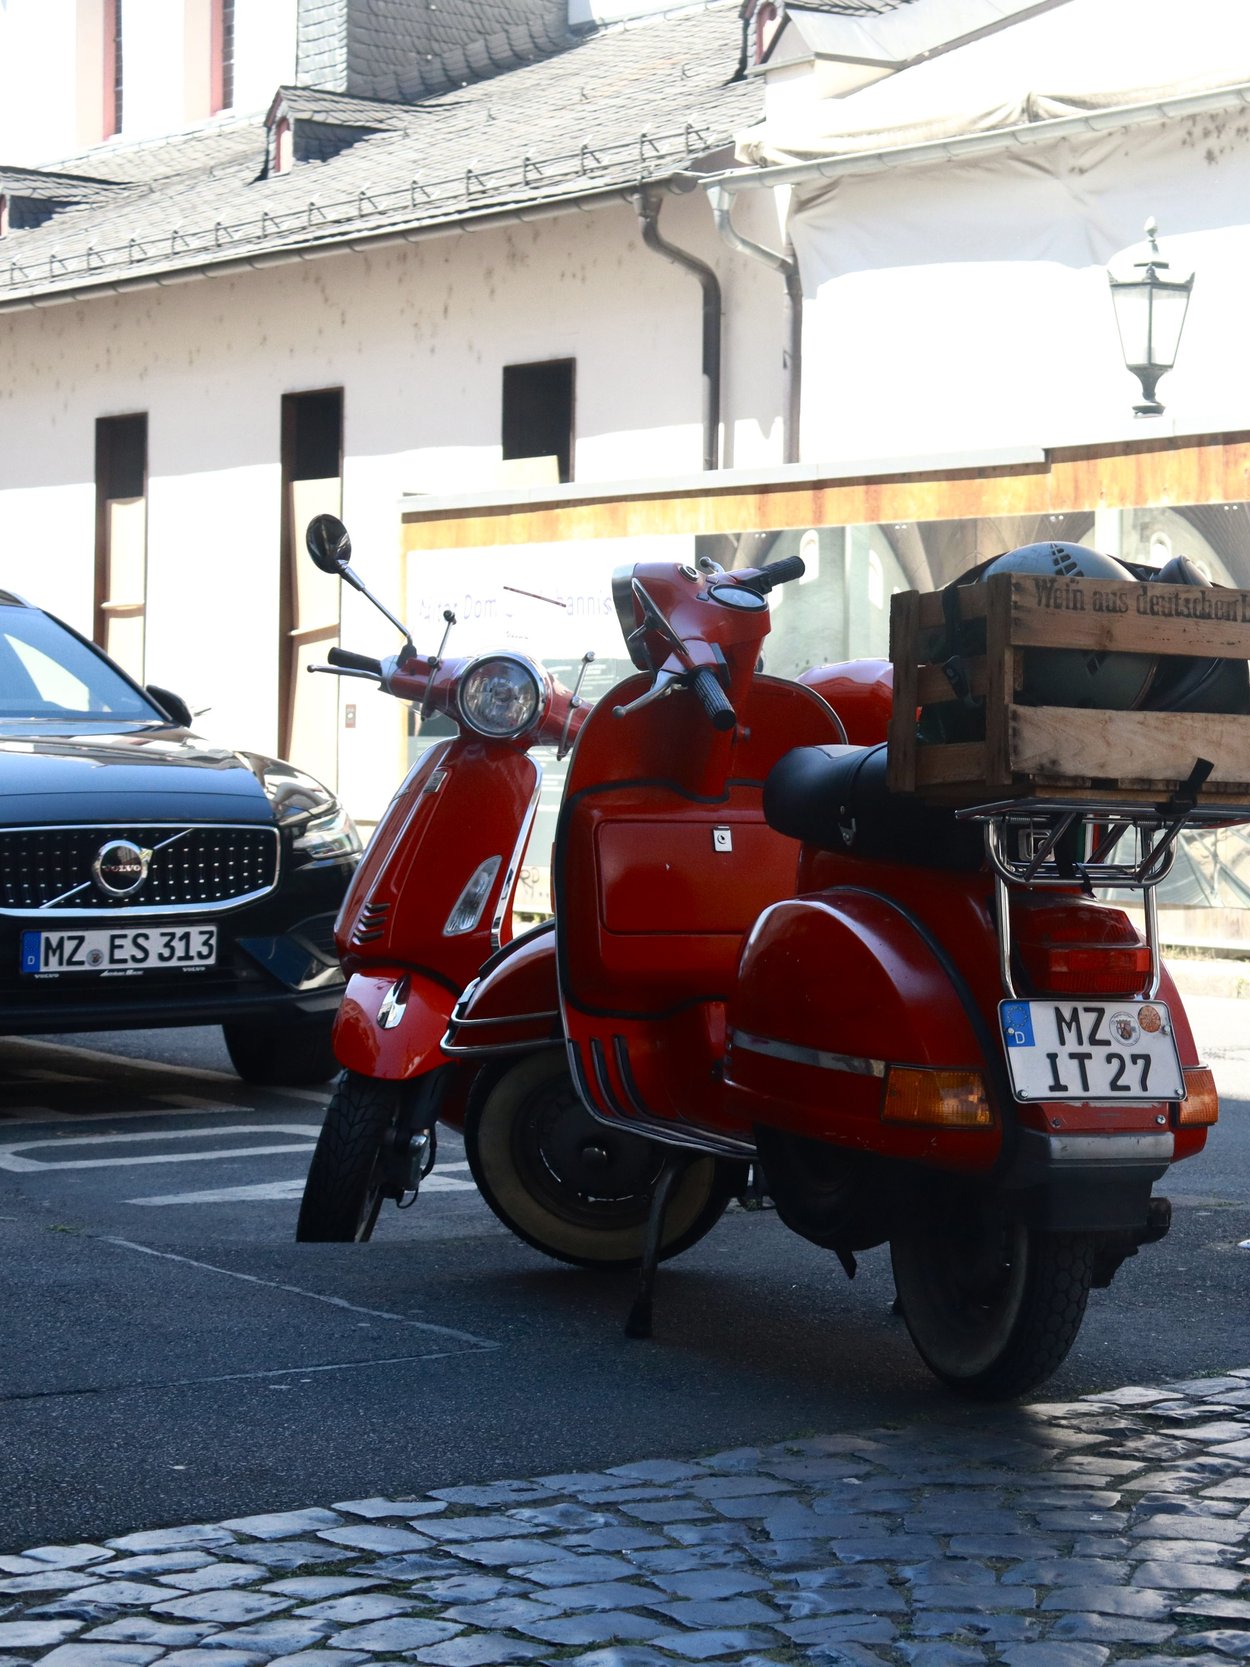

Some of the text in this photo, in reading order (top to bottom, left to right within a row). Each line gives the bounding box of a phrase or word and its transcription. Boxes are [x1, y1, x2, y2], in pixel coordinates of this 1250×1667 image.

[1032, 577, 1086, 611] Wein
[1093, 590, 1129, 613] aus
[102, 864, 141, 872] VOLVO
[28, 930, 215, 967] D MZ ES 313
[1015, 1007, 1111, 1046] D MZ
[1046, 1052, 1152, 1092] IT 27
